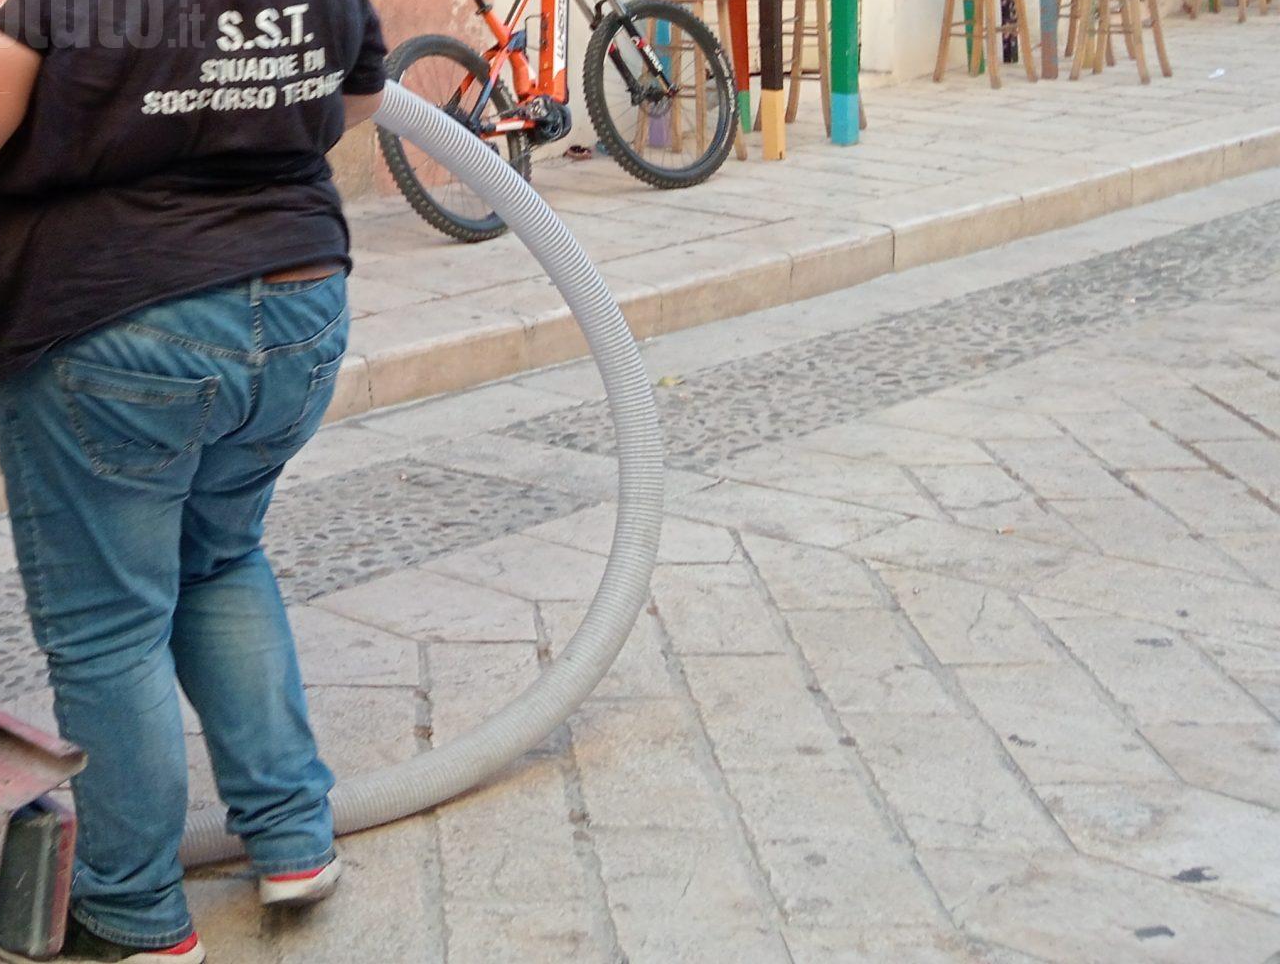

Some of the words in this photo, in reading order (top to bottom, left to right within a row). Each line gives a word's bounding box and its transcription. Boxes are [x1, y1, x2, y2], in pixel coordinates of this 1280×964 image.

[215, 3, 315, 52] S.S.T.
[199, 53, 300, 85] SQUADRE
[303, 47, 326, 74] DI
[141, 85, 277, 116] SOCCORSO
